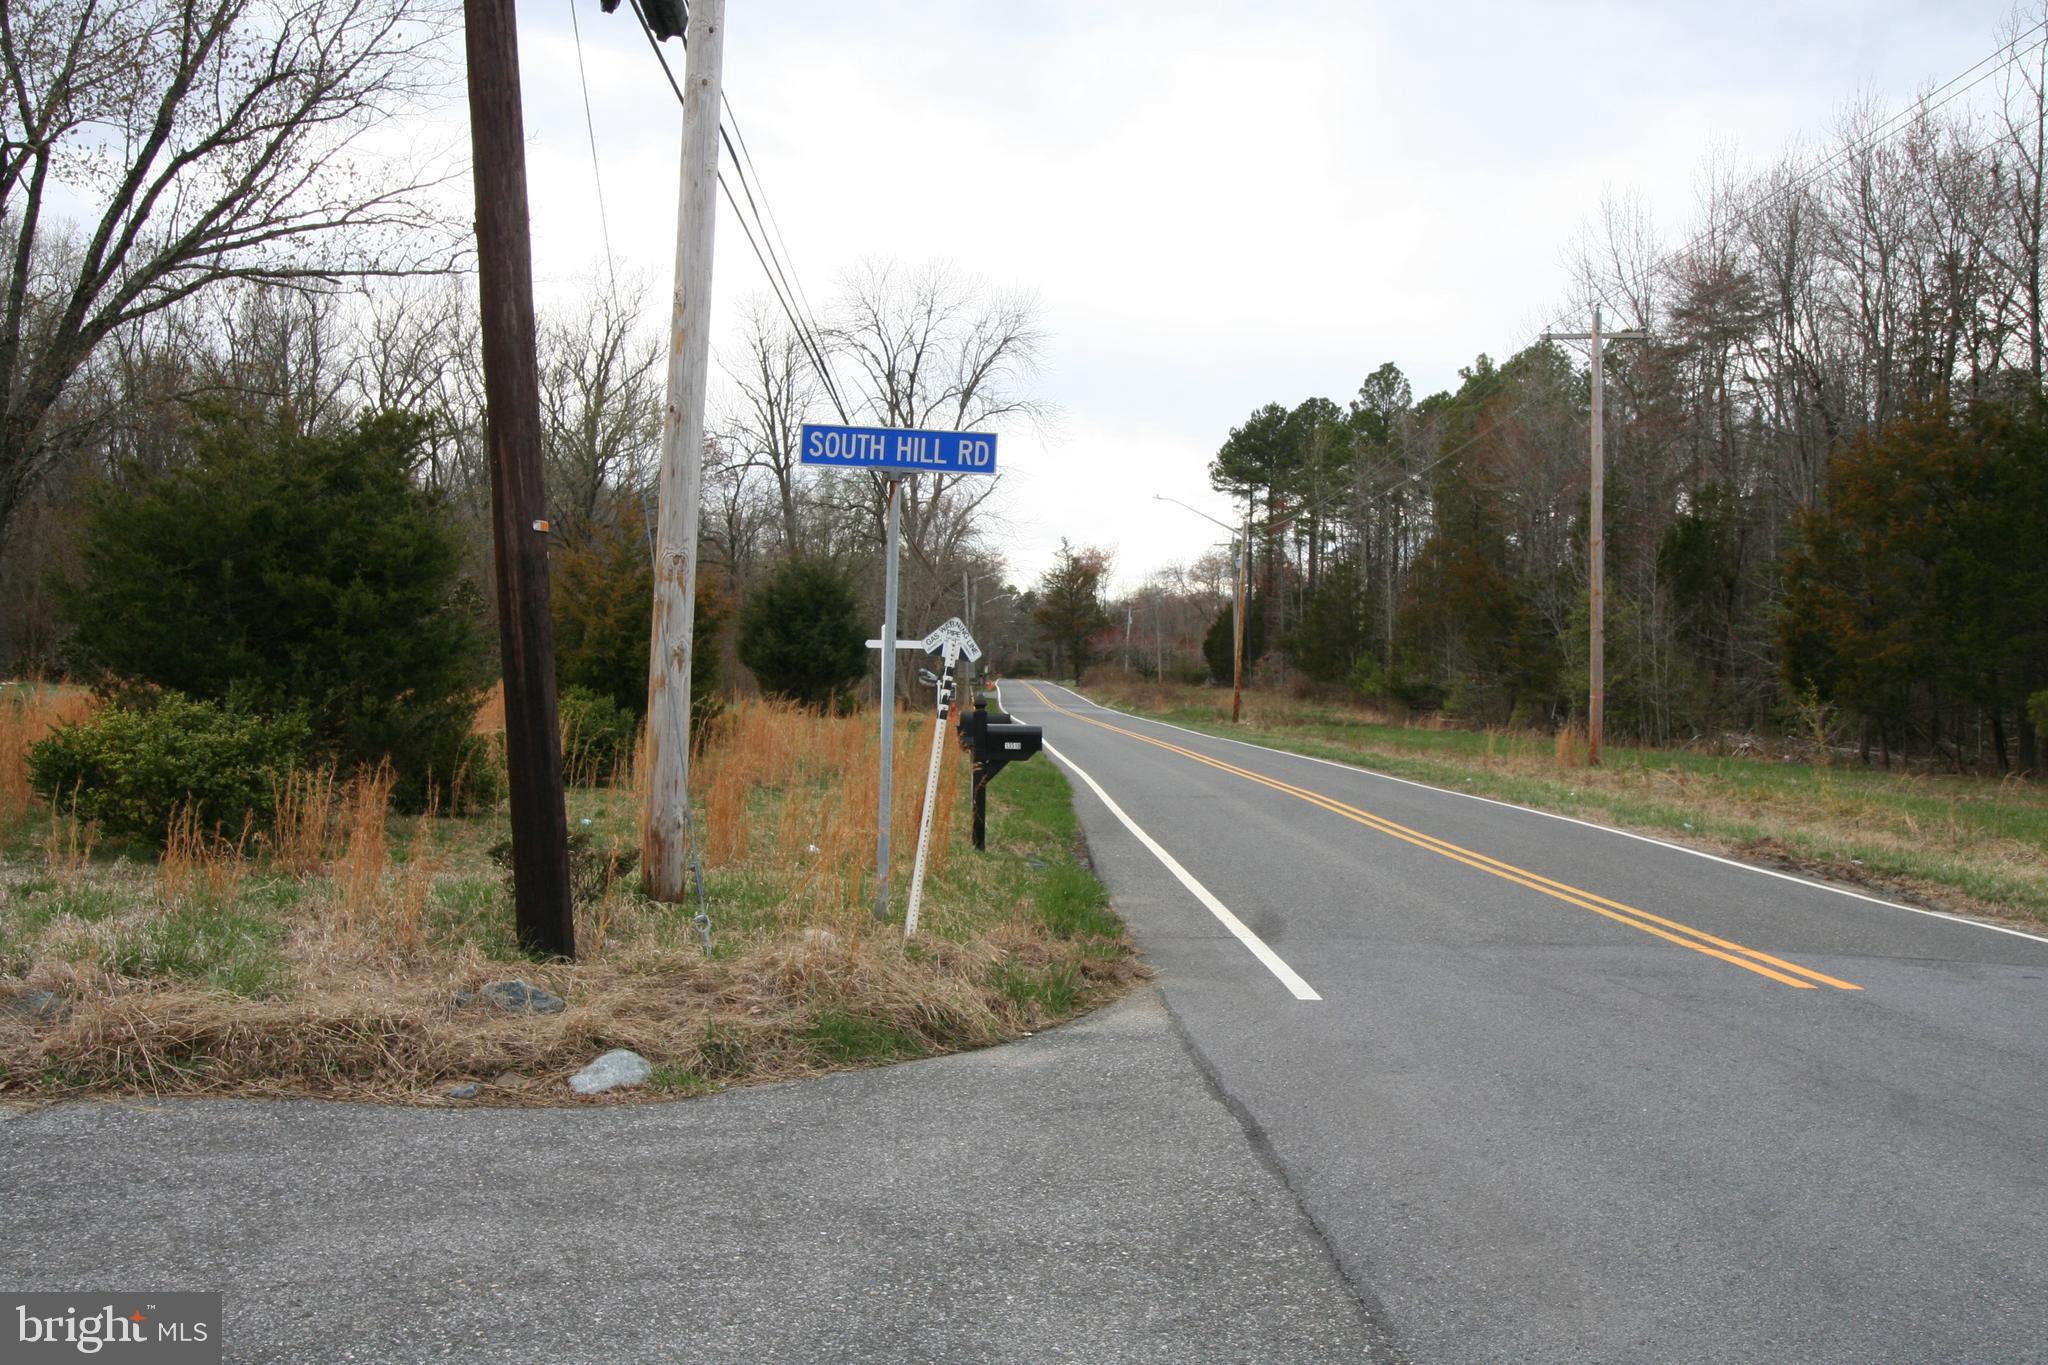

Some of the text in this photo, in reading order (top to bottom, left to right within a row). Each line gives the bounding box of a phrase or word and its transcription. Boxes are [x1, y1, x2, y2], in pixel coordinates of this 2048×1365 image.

[809, 431, 989, 466] SOUTH HILL RD
[925, 633, 940, 646] GAS
[946, 629, 961, 637] PIPE
[966, 639, 979, 655] LINE
[939, 620, 970, 640] WARNING
